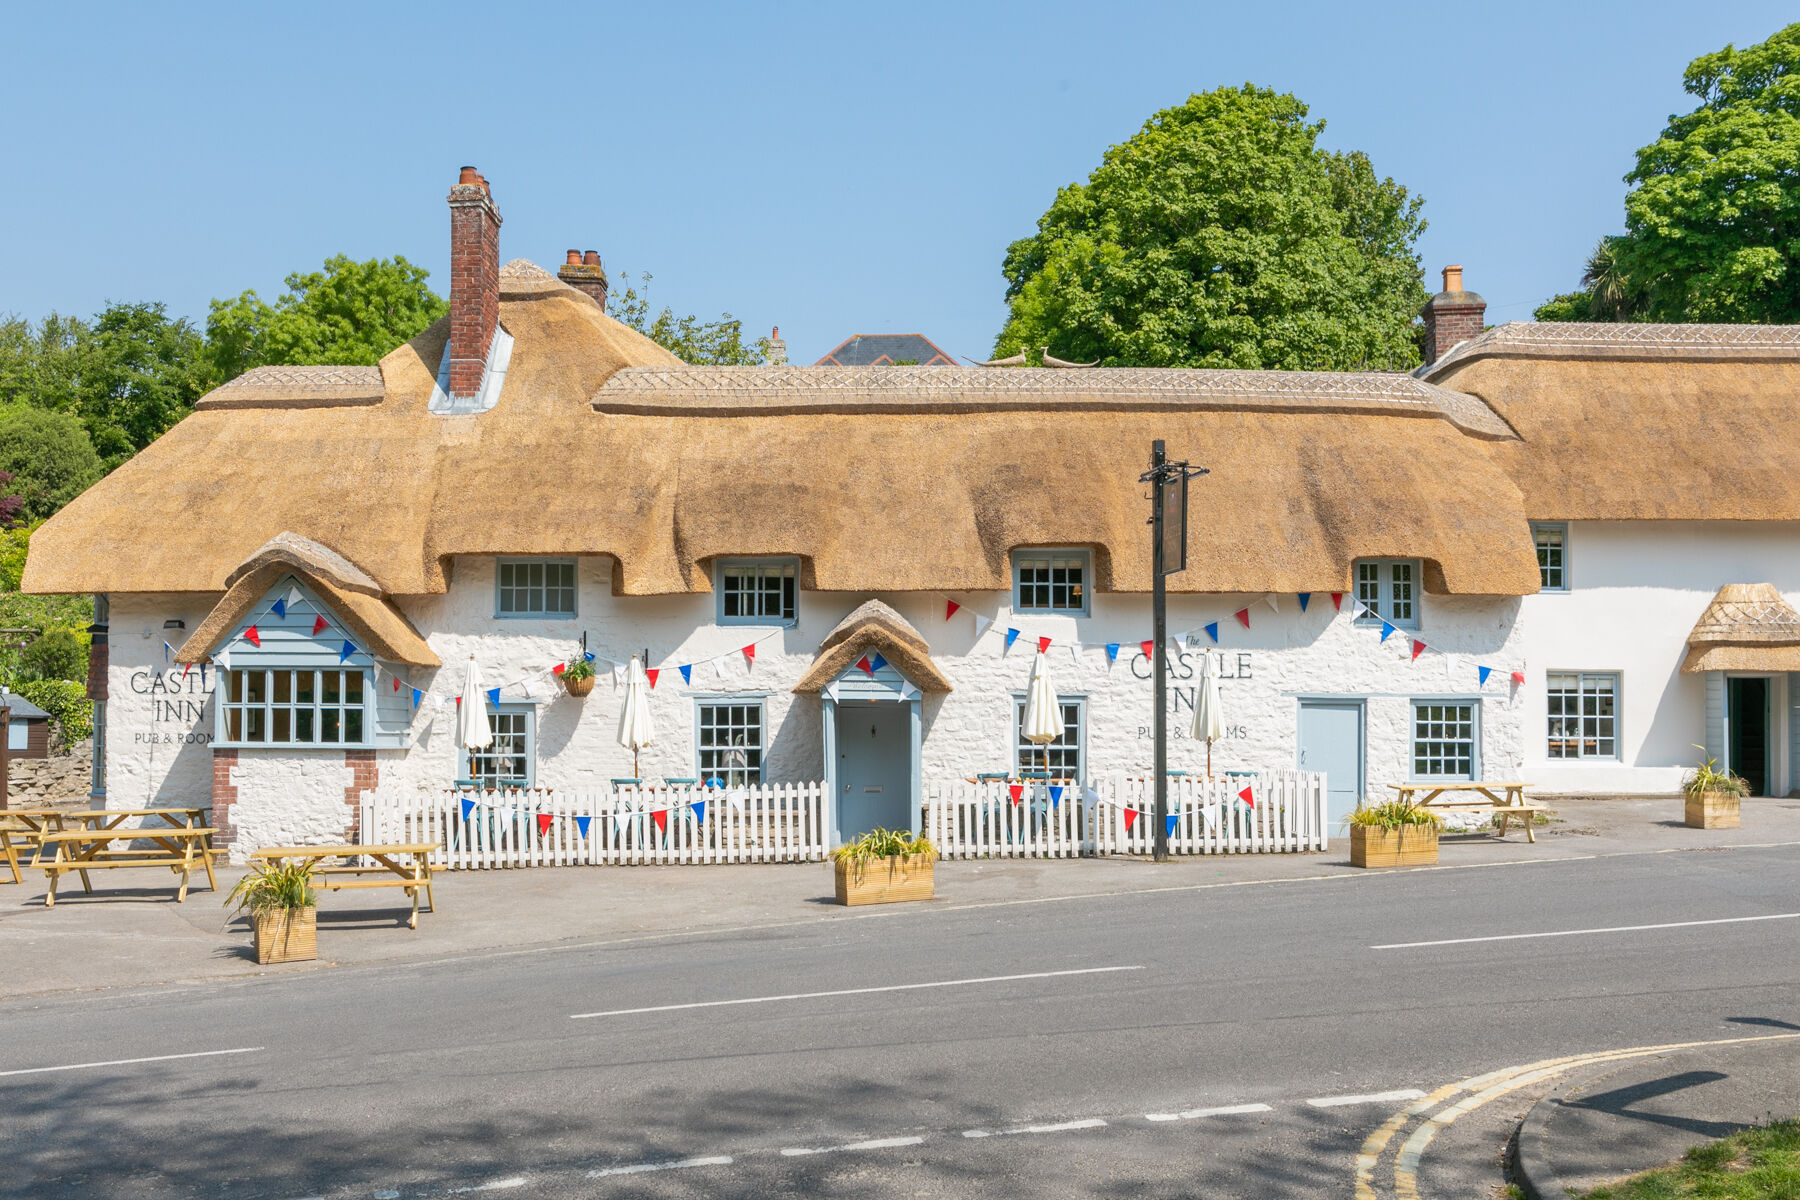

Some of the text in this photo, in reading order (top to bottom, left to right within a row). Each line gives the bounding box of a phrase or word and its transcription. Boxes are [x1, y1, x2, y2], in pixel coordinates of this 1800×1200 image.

[131, 671, 215, 694] CASTL
[155, 700, 205, 722] INN
[135, 733, 215, 744] PUB & ROOM
[1173, 726, 1184, 740] &
